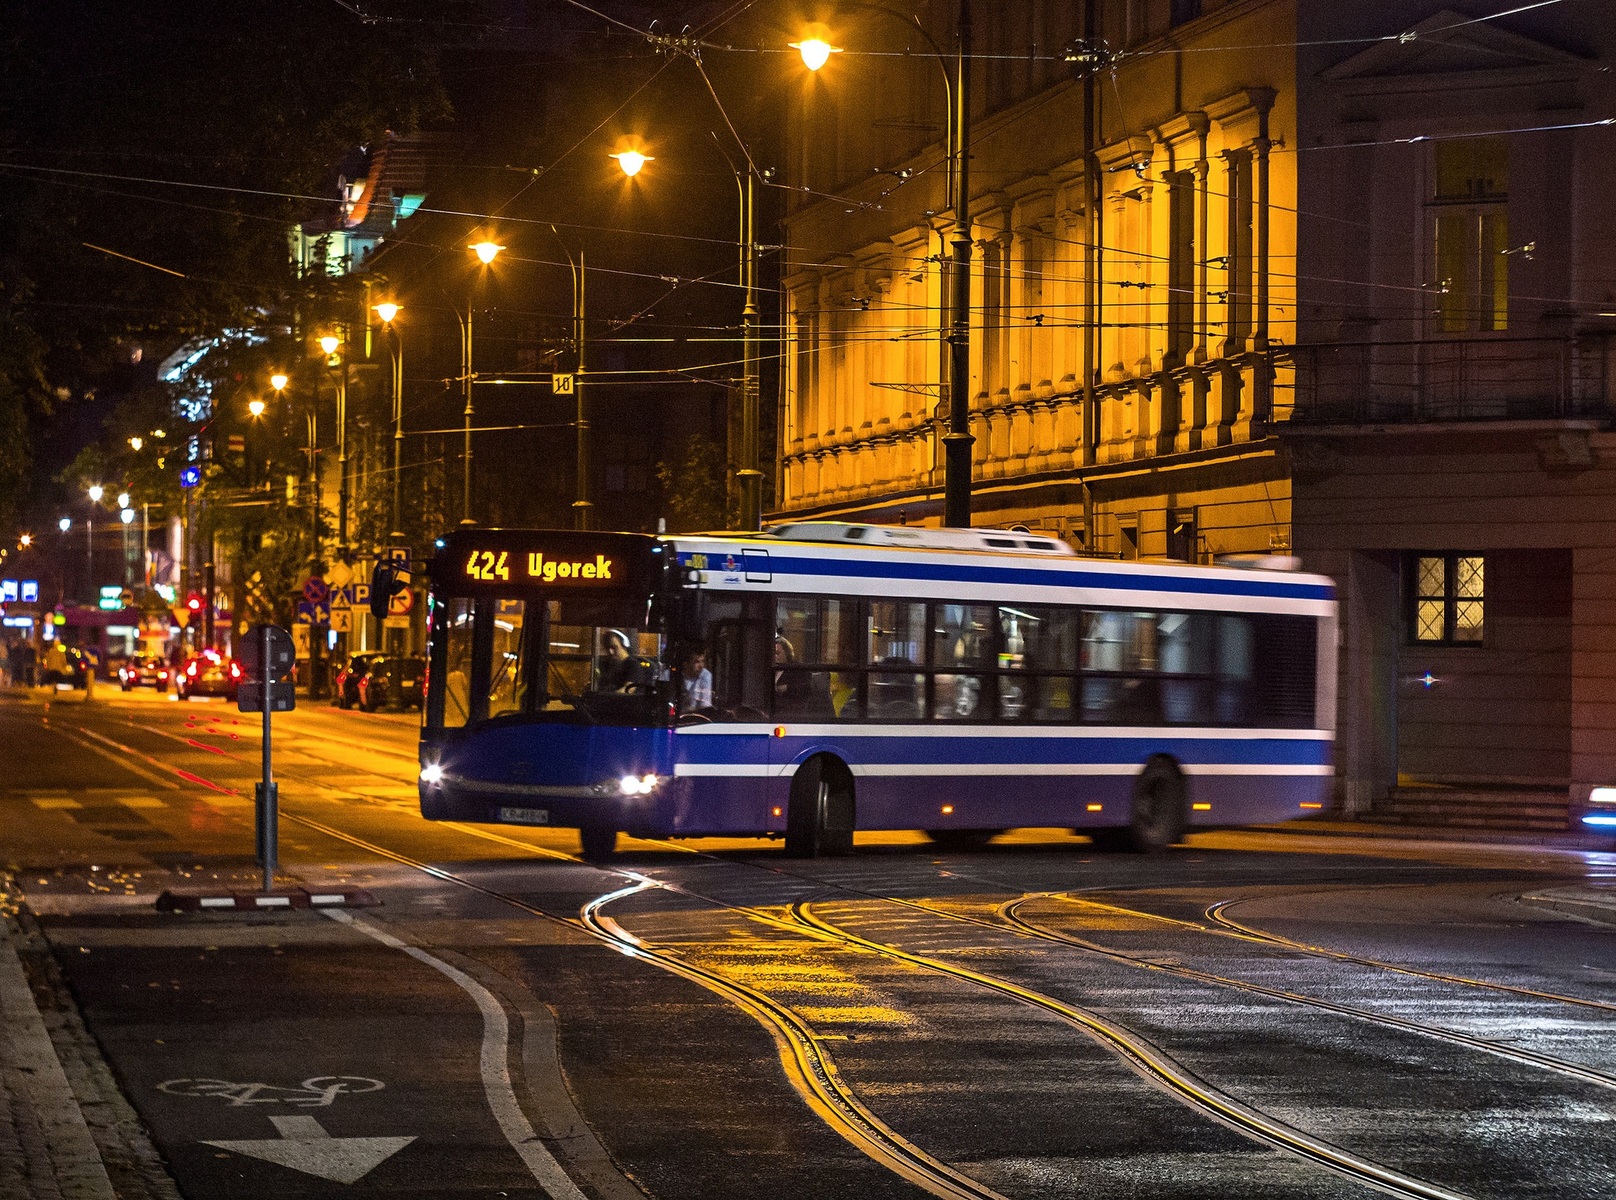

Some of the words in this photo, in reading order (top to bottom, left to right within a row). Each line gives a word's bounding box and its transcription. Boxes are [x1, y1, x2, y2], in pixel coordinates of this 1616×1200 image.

[555, 377, 570, 391] 10
[466, 551, 509, 580] 424
[528, 553, 612, 582] Ugorek
[356, 585, 369, 602] P
